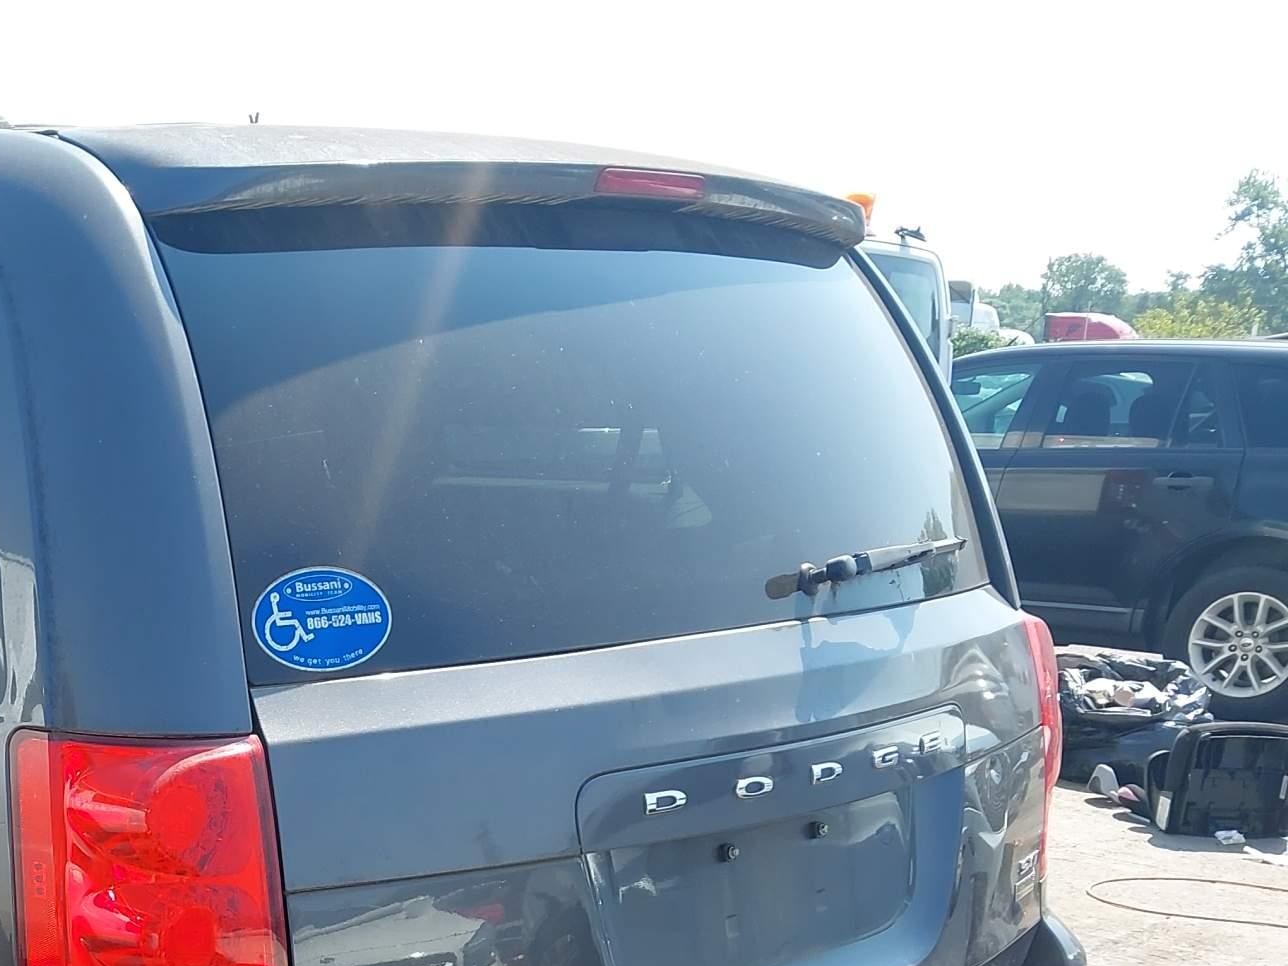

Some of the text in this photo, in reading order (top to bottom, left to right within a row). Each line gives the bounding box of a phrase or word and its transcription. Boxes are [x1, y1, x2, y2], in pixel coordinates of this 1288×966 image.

[295, 578, 341, 592] Bussani
[306, 611, 382, 630] 866-524-VANS
[293, 648, 364, 667] we get you there
[643, 731, 945, 816] DODGE
